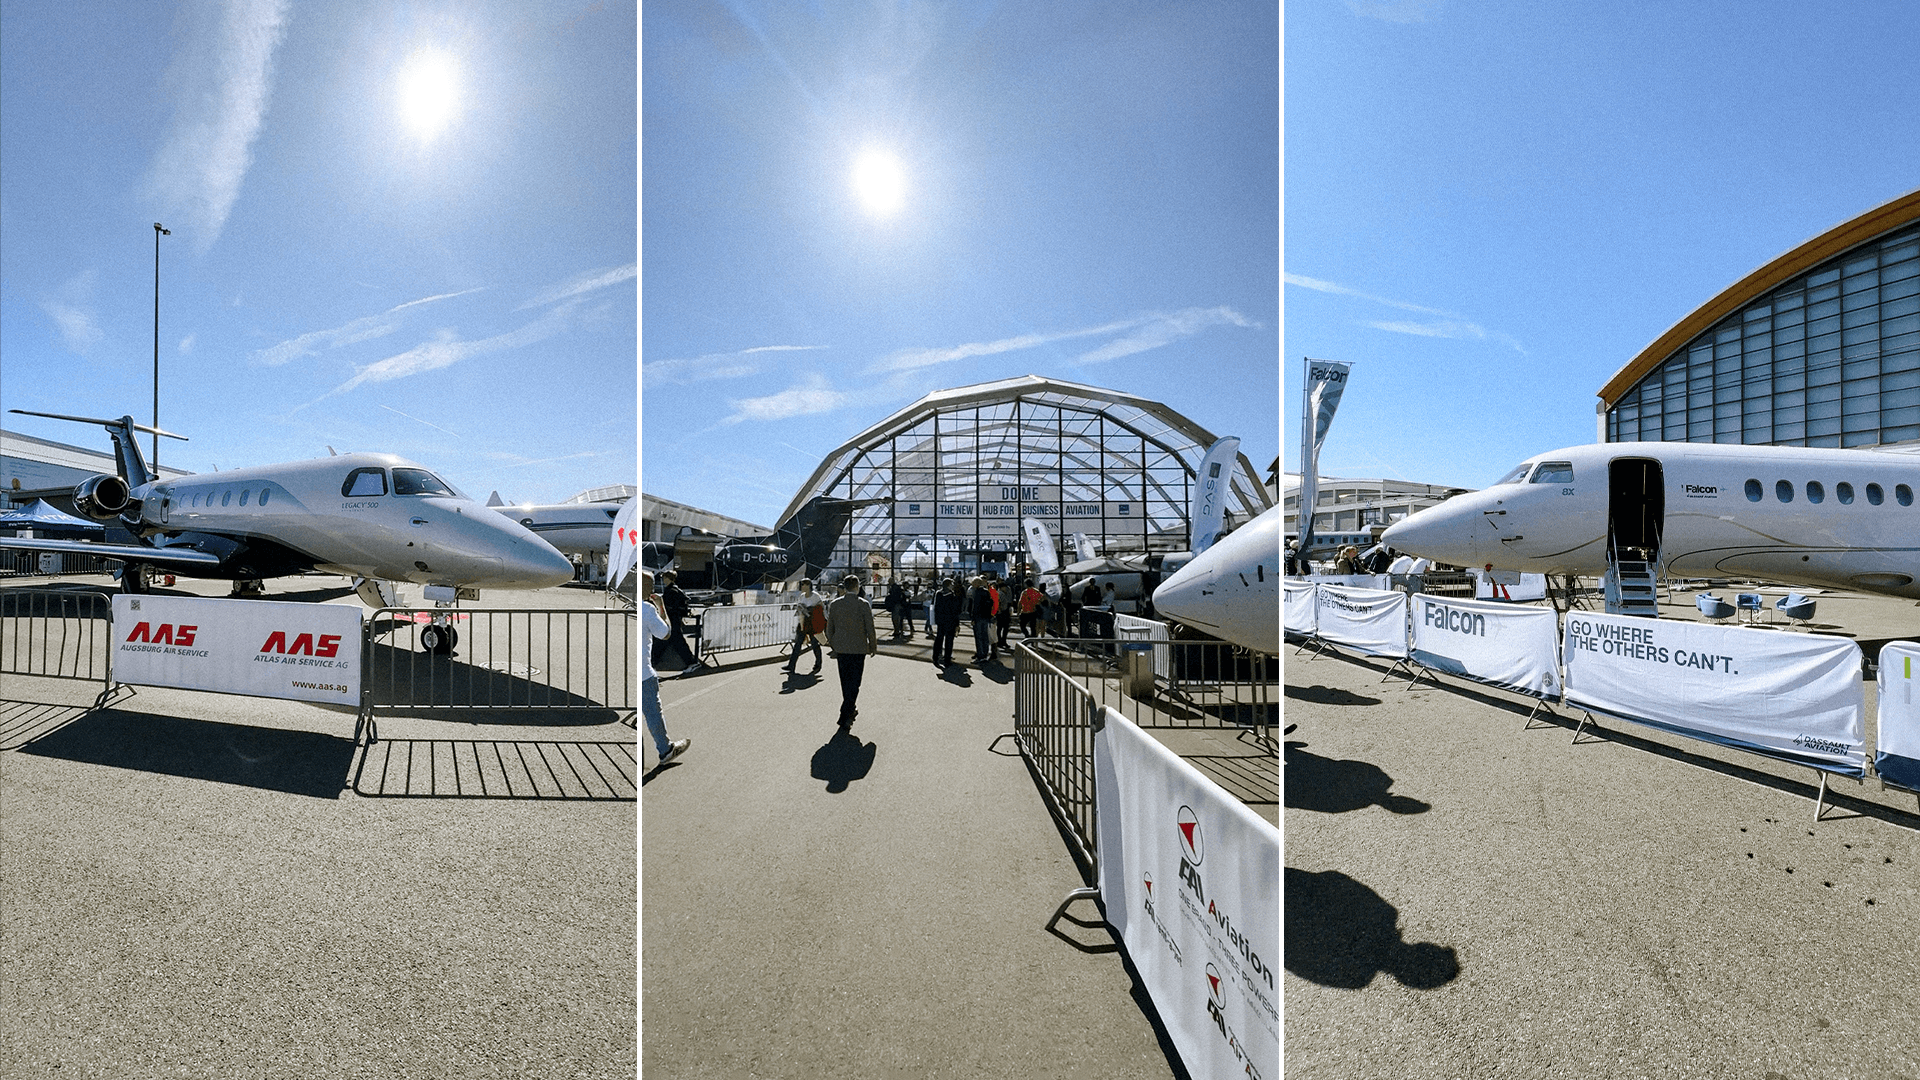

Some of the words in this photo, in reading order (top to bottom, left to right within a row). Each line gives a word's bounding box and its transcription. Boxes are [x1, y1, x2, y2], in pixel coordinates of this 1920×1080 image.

[1002, 487, 1039, 500] DOME
[1562, 488, 1574, 496] 8X
[1686, 484, 1717, 494] Falcon
[367, 501, 379, 509] 500
[940, 505, 954, 515] THE
[956, 505, 974, 515] NEW
[982, 505, 998, 515] HUB
[1000, 505, 1014, 515] FOR
[1022, 505, 1059, 515] BUSINESS
[1065, 505, 1100, 515] AVIATION
[743, 552, 788, 564] D-CJMS
[1320, 598, 1331, 608] THE
[740, 612, 771, 624] PILOTS
[1425, 602, 1485, 637] Falcon
[126, 621, 198, 647] AAS
[1571, 620, 1591, 635] GO
[1595, 623, 1653, 645] WHERE
[120, 644, 162, 653] AUGSBURG
[177, 649, 209, 658] SERVICE
[260, 631, 342, 658] AAS
[1571, 634, 1598, 652] THE
[1602, 639, 1669, 663] OTHERS
[254, 655, 280, 664] ATLAS
[281, 657, 297, 665] AIR
[298, 658, 334, 668] SERVICE
[335, 661, 349, 669] AG
[291, 681, 348, 694] www.aas.ag
[1804, 736, 1852, 750] DASSAULT
[1804, 743, 1848, 756] AVIATION
[1208, 899, 1273, 991] Aviation
[1229, 1037, 1243, 1063] Air
